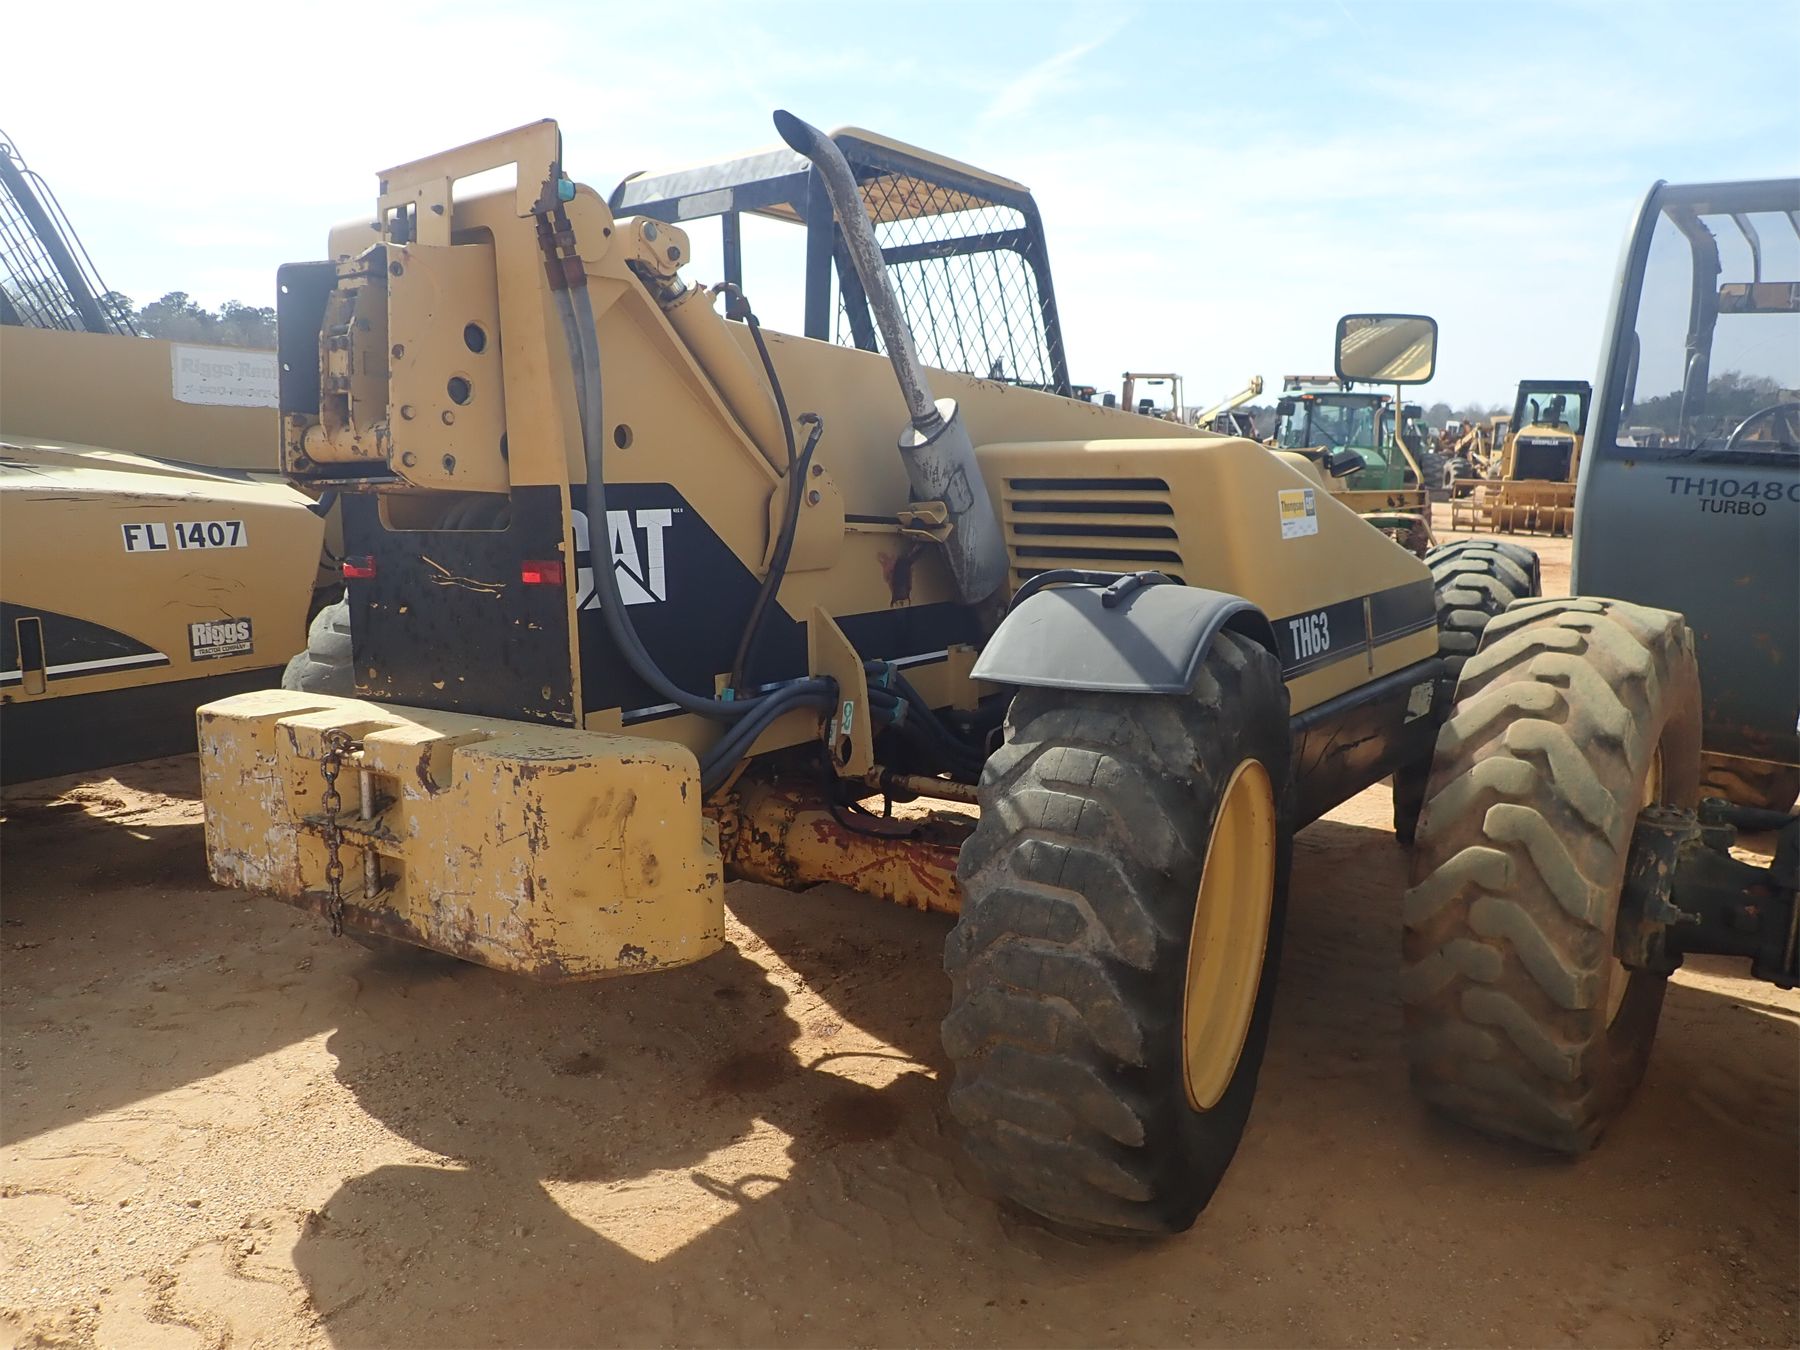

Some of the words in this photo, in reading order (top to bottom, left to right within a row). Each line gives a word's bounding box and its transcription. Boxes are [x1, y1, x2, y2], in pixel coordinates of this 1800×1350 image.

[1699, 498, 1767, 516] TURBO
[123, 524, 167, 551] FL
[175, 521, 241, 549] 1407
[191, 621, 250, 647] Riggs
[1289, 611, 1330, 660] TH63
